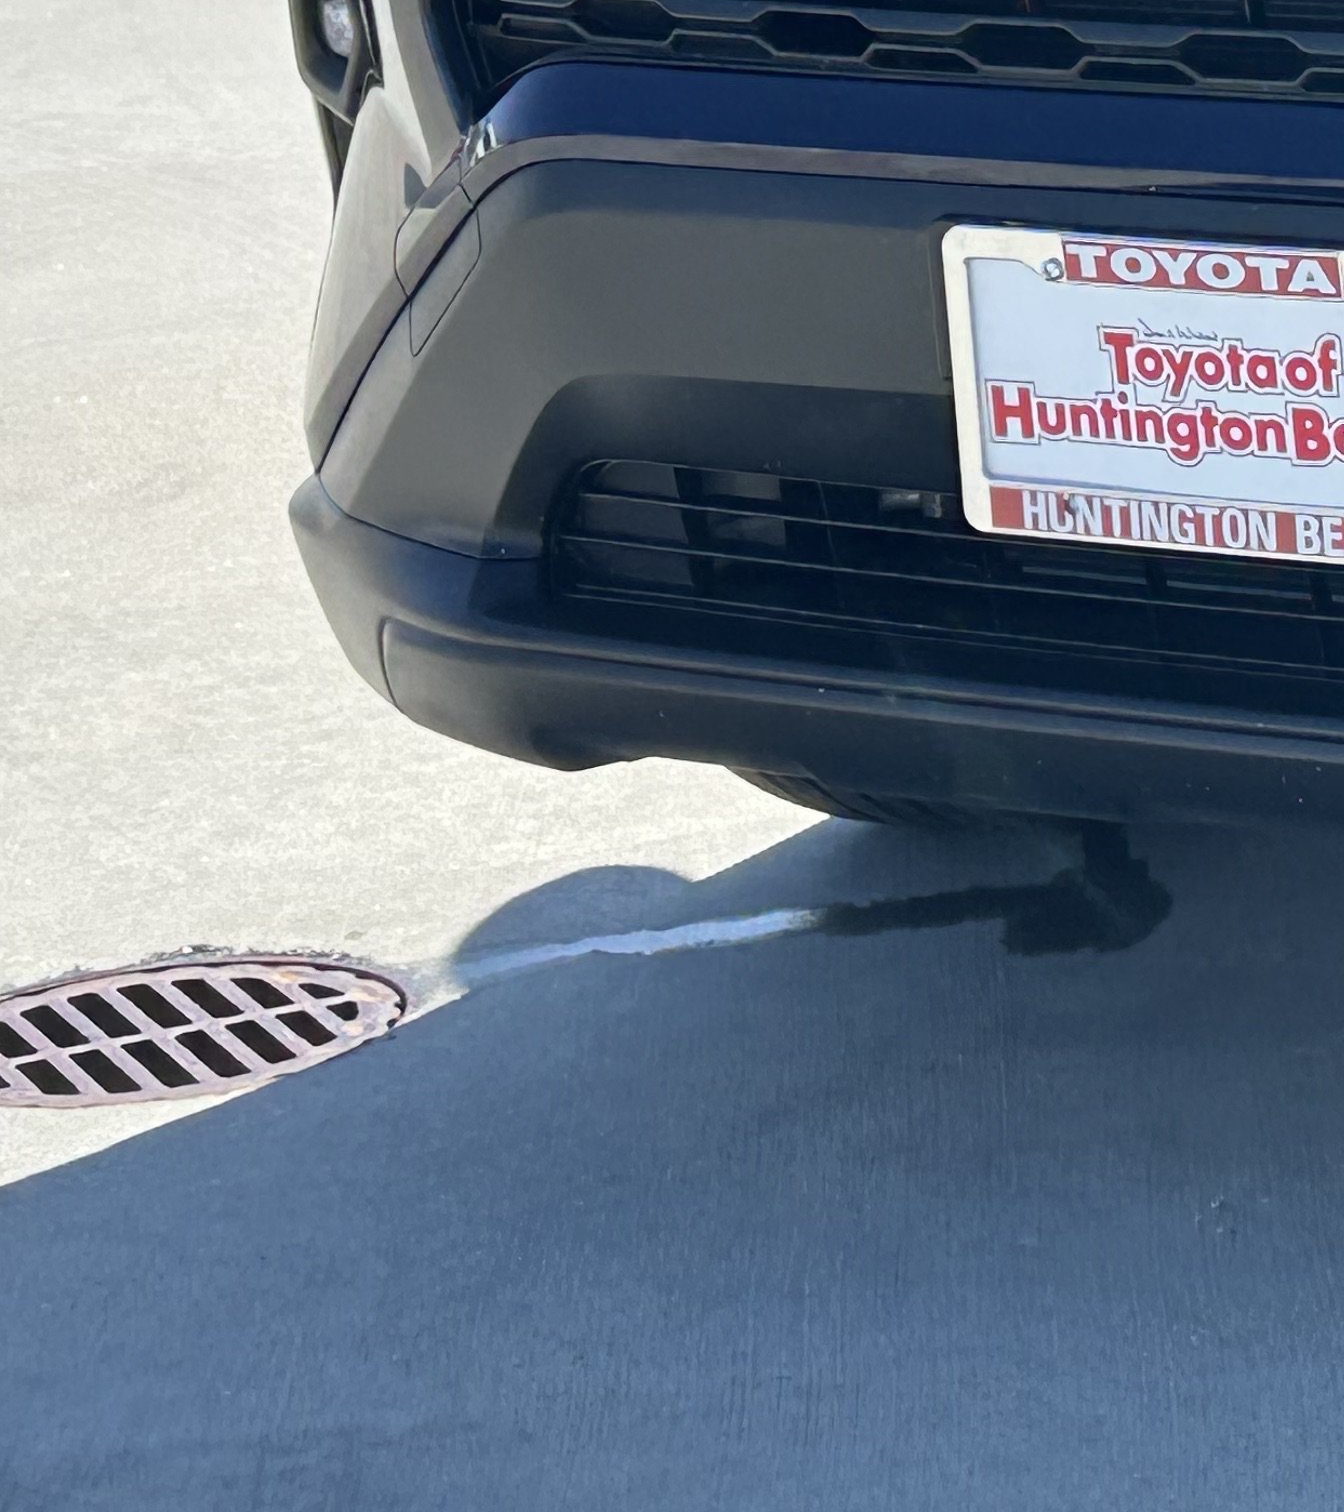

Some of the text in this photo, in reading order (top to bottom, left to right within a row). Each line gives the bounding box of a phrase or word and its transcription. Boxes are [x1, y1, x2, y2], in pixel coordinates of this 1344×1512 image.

[1066, 244, 1337, 295] TOYOTA
[1103, 330, 1340, 399] Toyota of
[990, 383, 1288, 460] Huntington
[1022, 489, 1277, 552] HUNTINGTON
